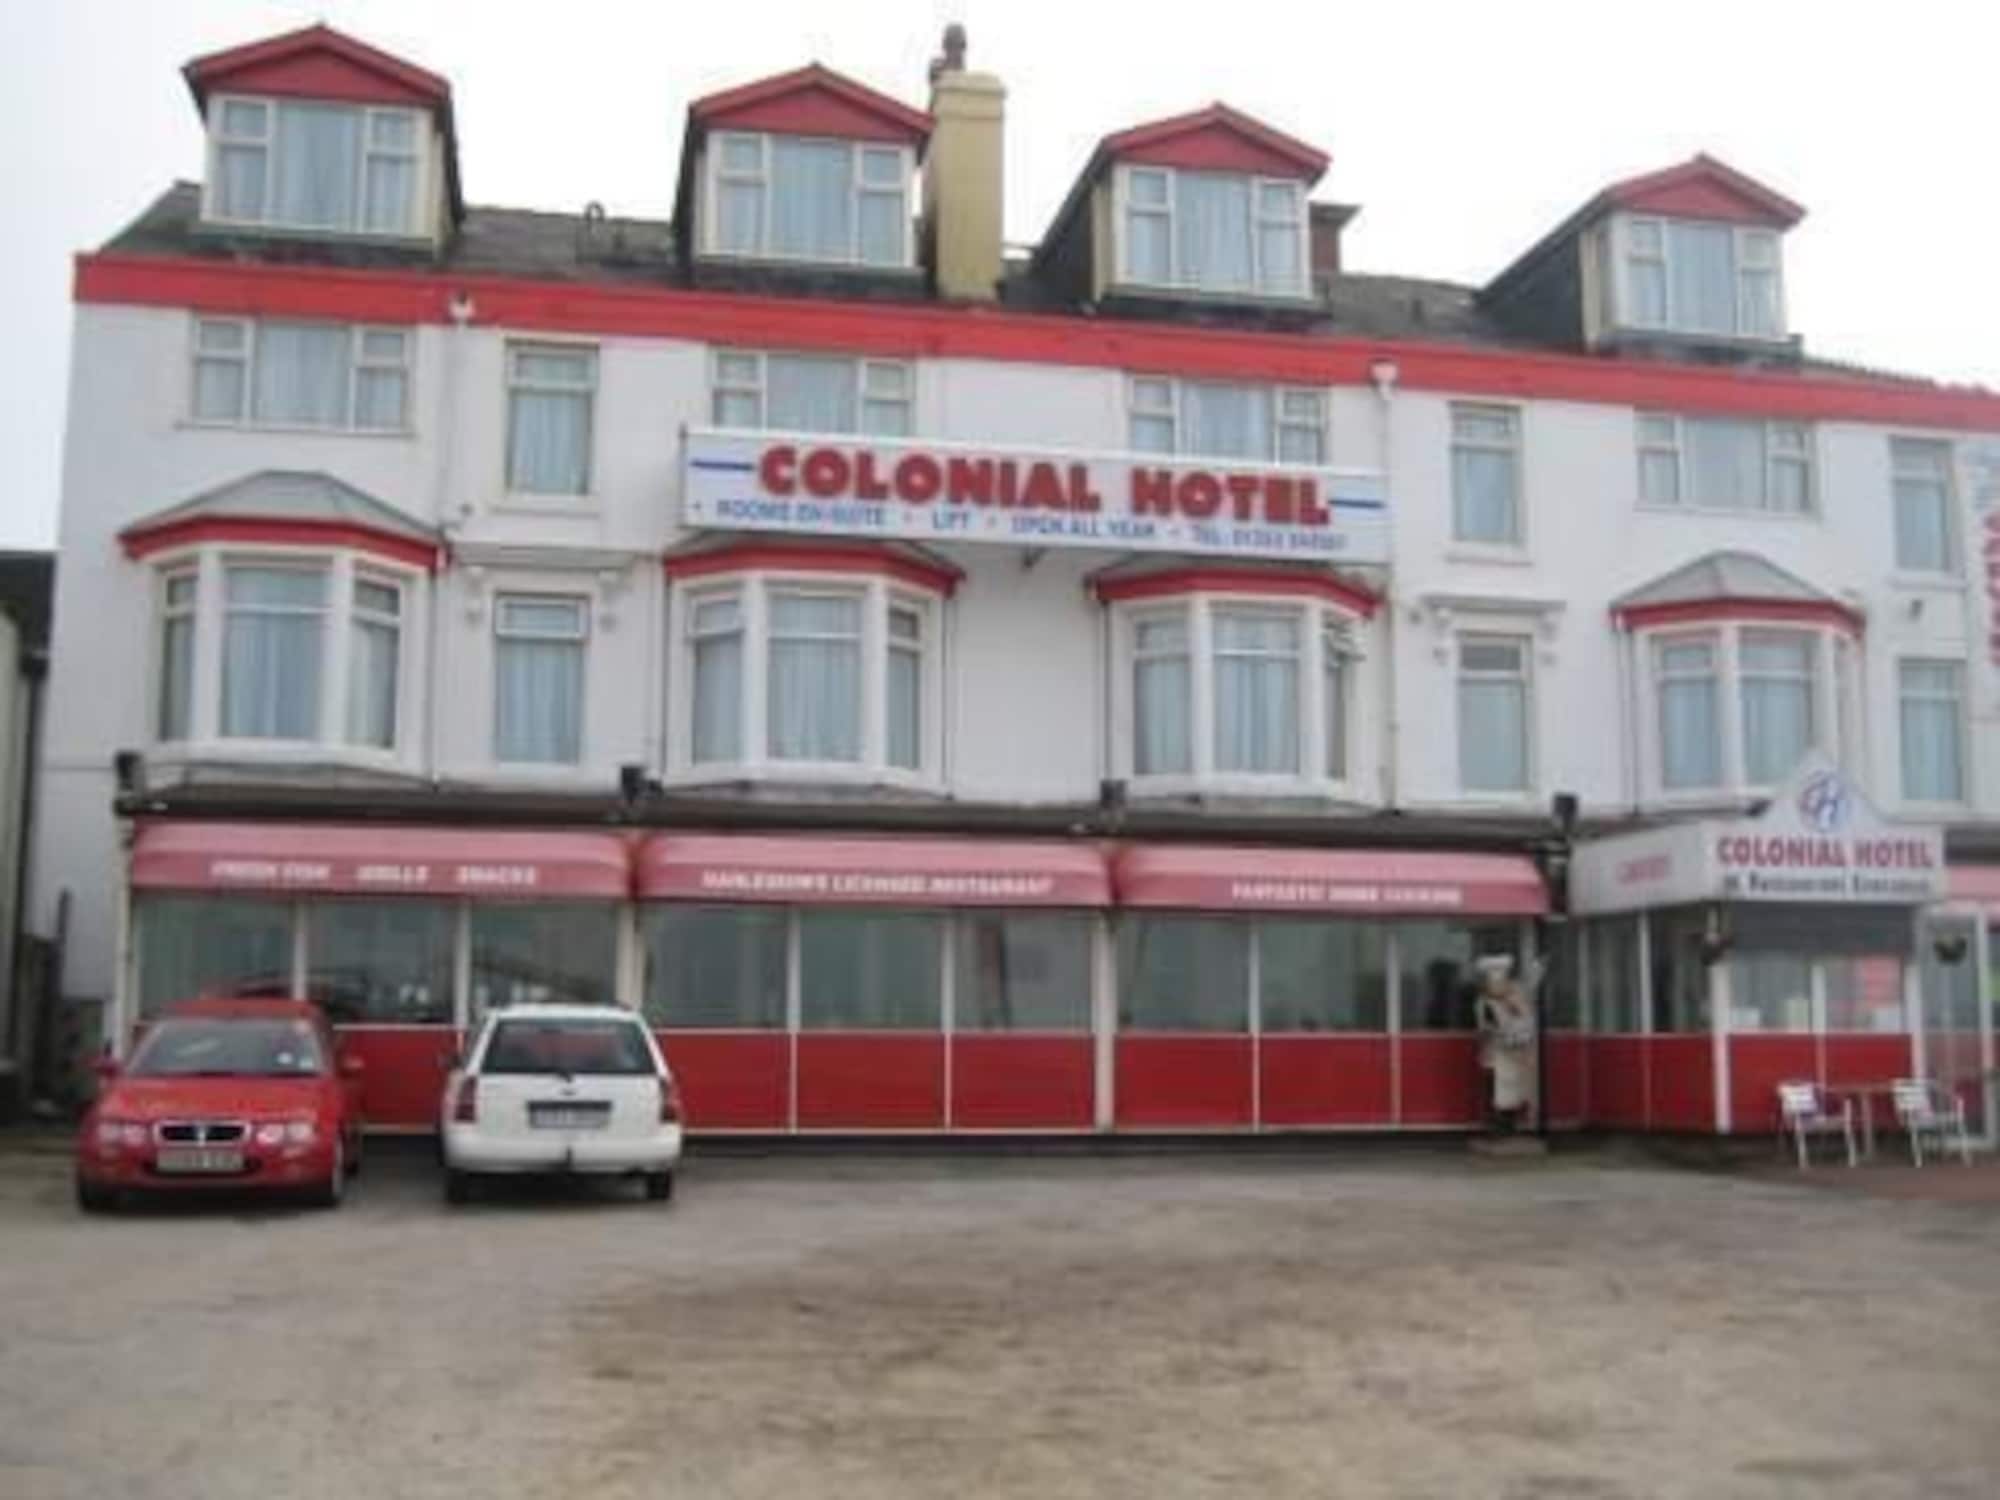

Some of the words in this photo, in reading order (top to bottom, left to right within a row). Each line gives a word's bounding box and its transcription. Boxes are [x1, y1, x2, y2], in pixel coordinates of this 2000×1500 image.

[760, 446, 1101, 513] COLONIAL
[1132, 467, 1330, 525] HOTEL
[933, 511, 970, 530] LIFT
[1011, 517, 1068, 535] OPEN
[1071, 519, 1100, 537] ALL
[1109, 521, 1155, 538] YEAR
[1718, 836, 1847, 867] COLONIAL
[1855, 840, 1934, 868] HOTEL
